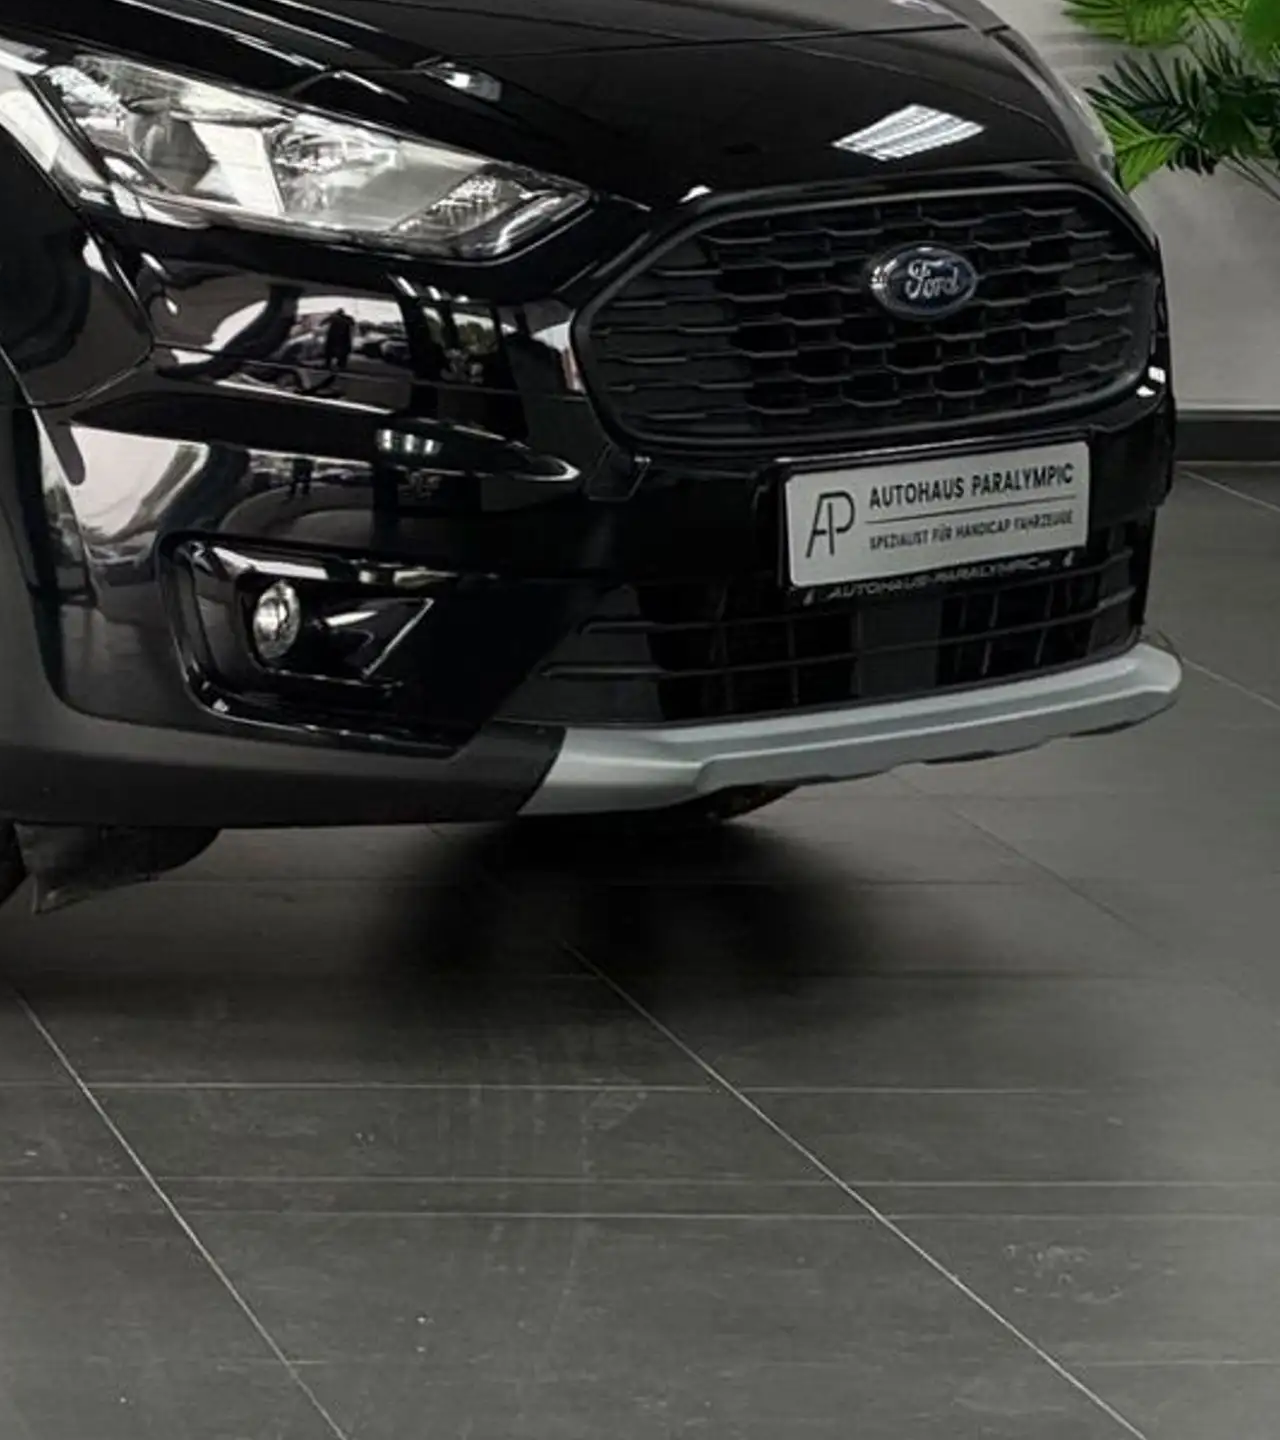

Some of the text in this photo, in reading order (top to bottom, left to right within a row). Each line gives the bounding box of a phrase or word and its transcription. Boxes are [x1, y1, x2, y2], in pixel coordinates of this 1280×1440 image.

[905, 259, 960, 301] Ford
[869, 462, 1075, 510] AUTOHAUS PARALYMPIC
[956, 517, 1012, 540] HANDICAP
